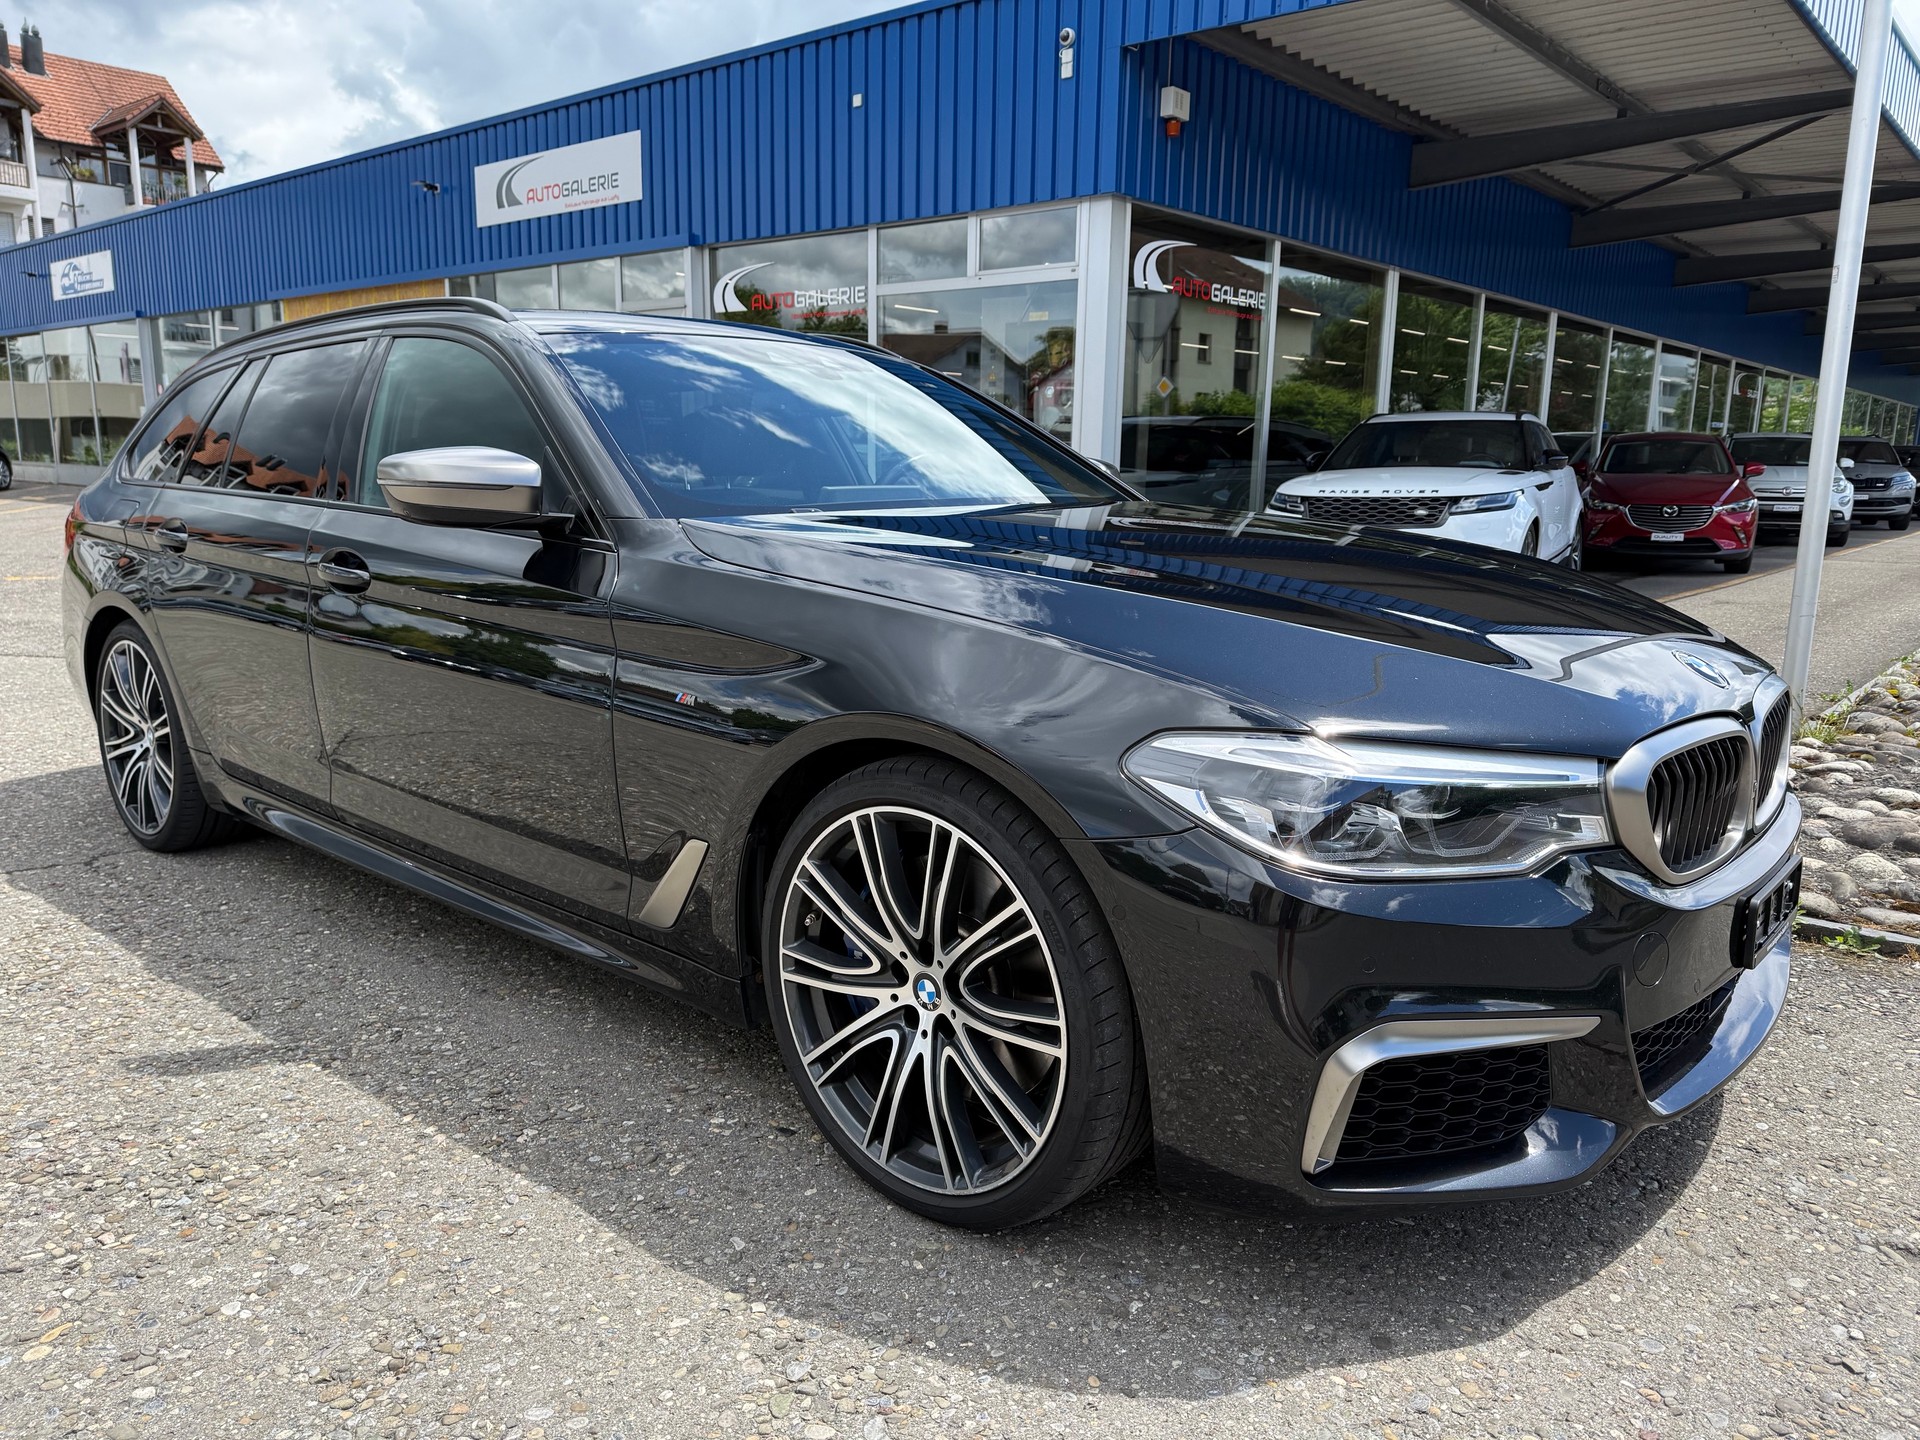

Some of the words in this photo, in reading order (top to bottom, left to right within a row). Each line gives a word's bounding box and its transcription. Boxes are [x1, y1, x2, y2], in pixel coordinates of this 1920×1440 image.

[526, 172, 619, 204] AUTOGALERIE
[751, 285, 866, 311] AUTOGALERIE
[1172, 276, 1267, 310] AUTOGALERIE
